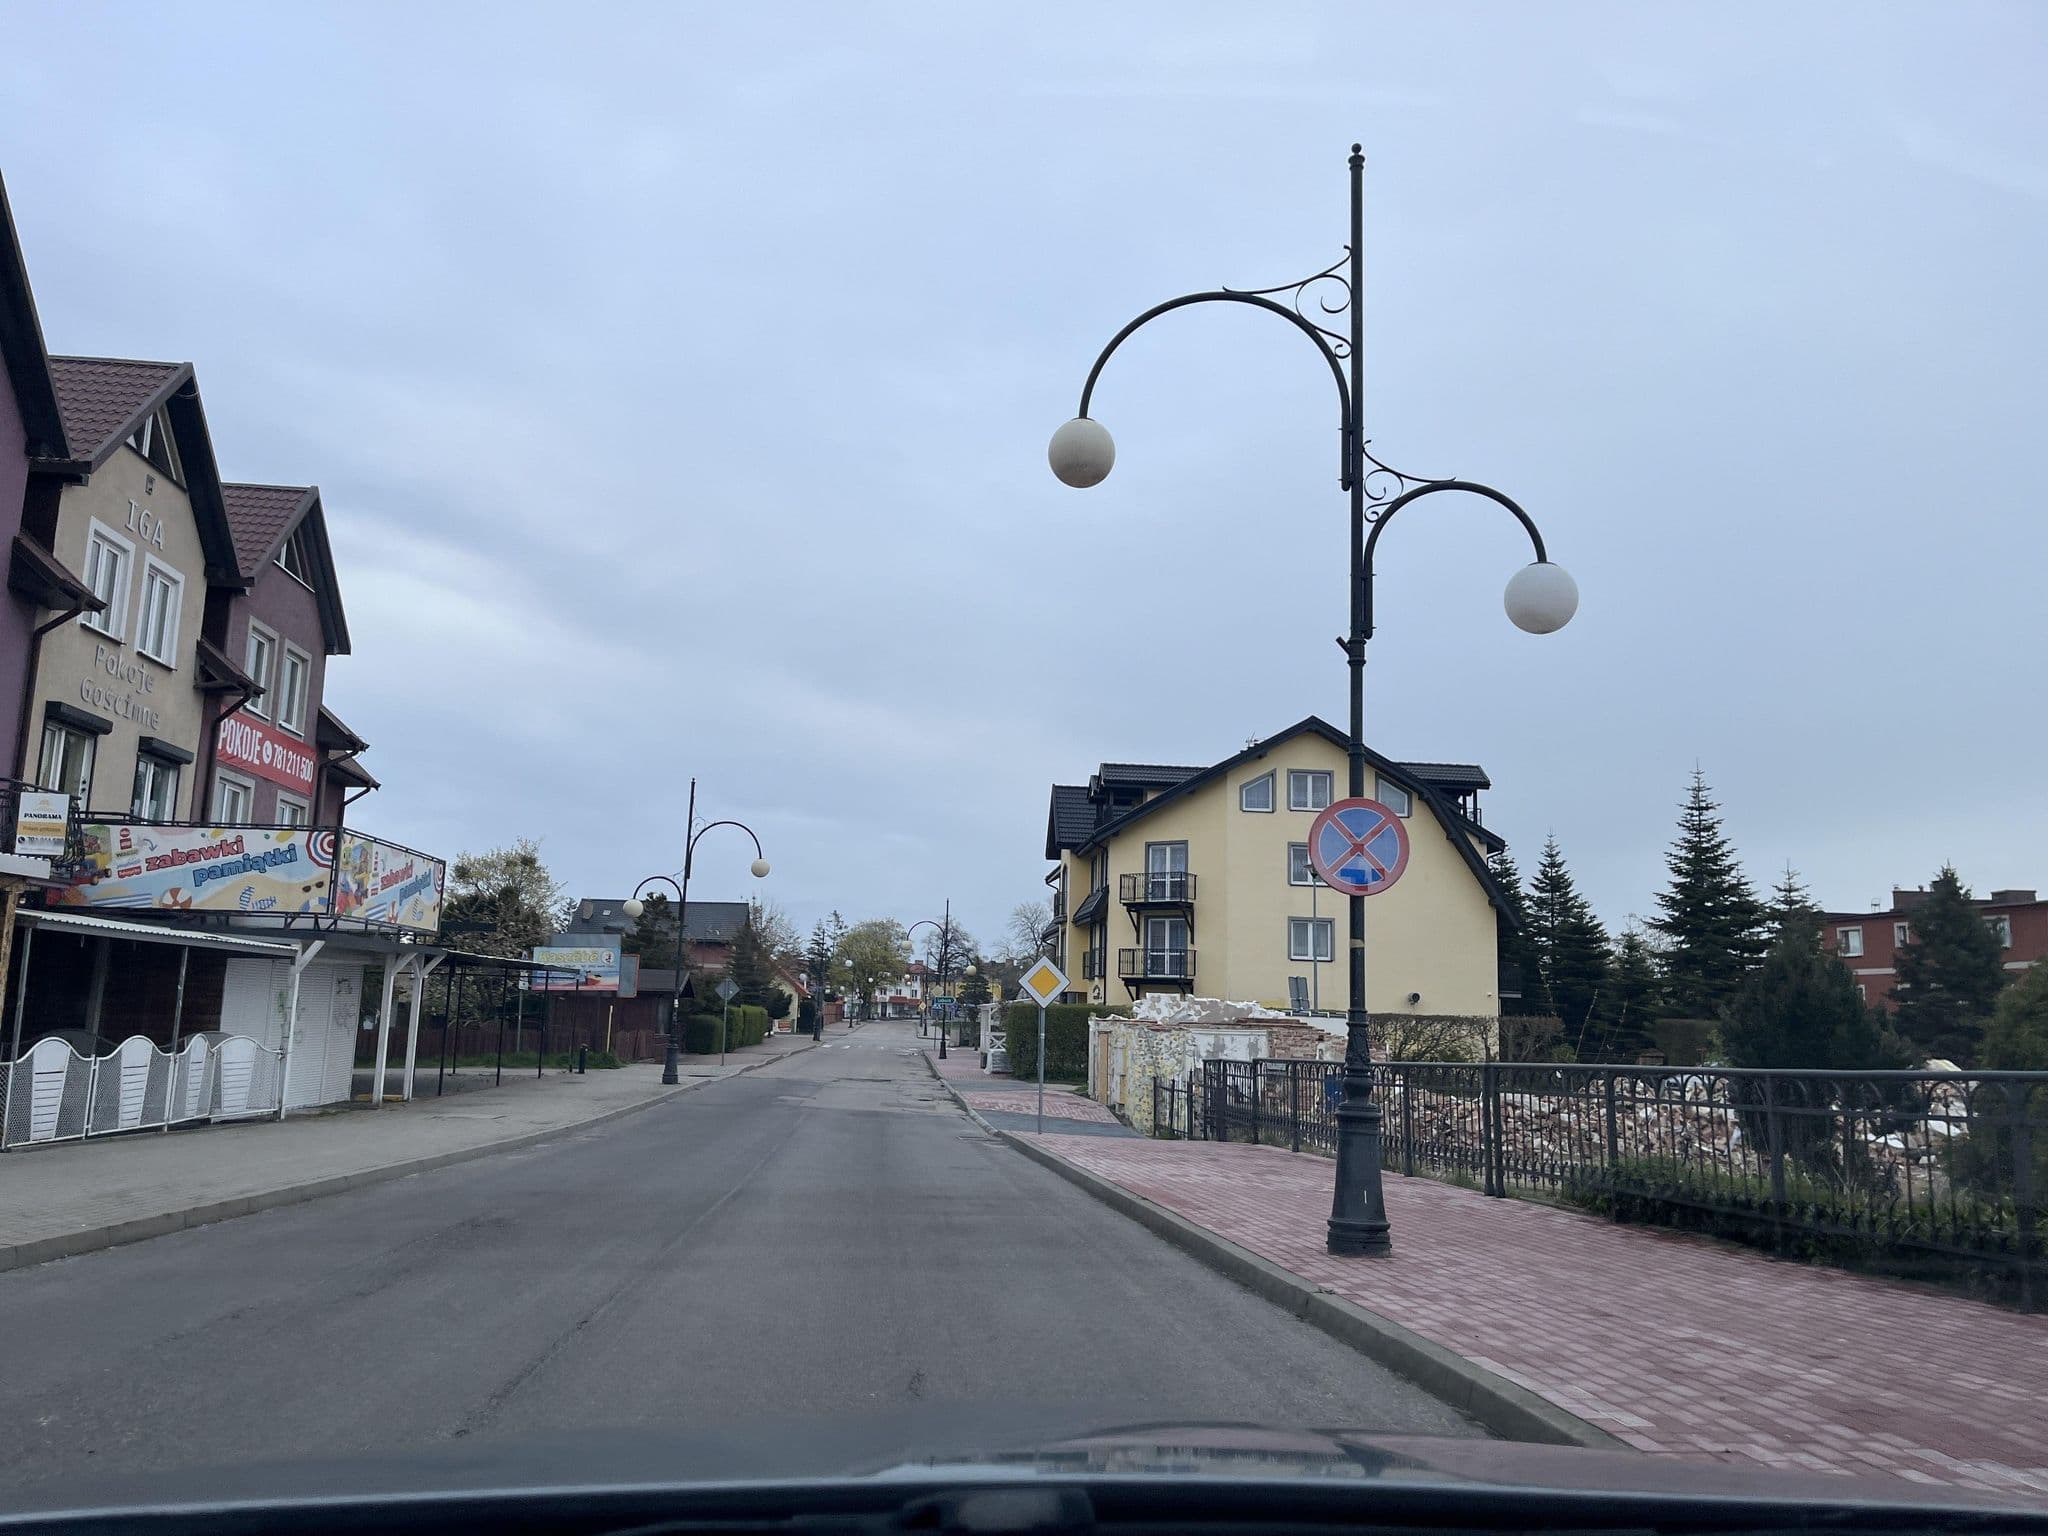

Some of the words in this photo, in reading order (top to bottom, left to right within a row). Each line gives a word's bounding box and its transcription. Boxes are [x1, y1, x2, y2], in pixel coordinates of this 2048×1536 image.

[124, 498, 166, 550] IGA
[94, 644, 154, 694] Pokoje
[217, 718, 263, 766] POKOJE
[273, 743, 287, 771] 781
[286, 750, 301, 777] 211
[300, 756, 314, 783] 500
[23, 812, 62, 820] PANORAMA
[145, 835, 245, 872] zabawki
[193, 843, 298, 888] pamiątki
